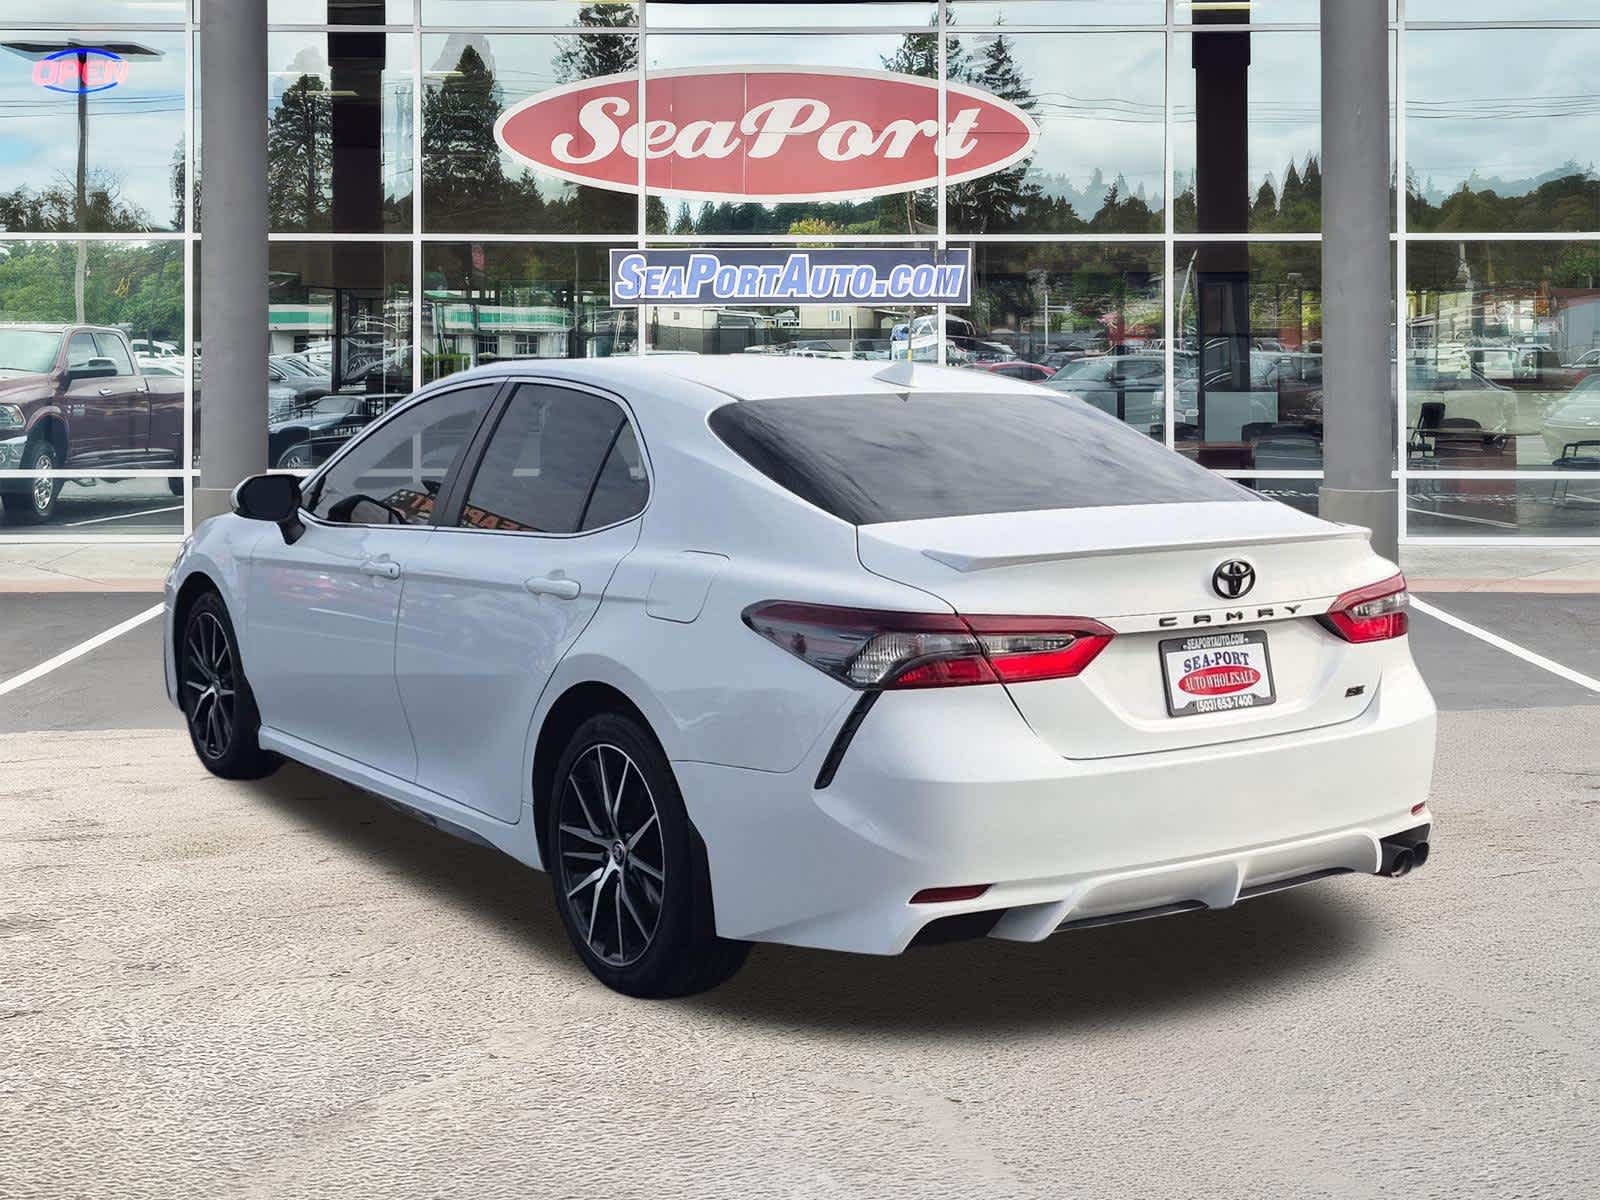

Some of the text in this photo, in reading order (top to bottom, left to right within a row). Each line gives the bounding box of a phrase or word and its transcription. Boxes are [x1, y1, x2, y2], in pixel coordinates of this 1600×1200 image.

[32, 59, 129, 86] OPEN
[550, 96, 982, 165] SeaPort
[1158, 604, 1302, 628] CAMRY
[1184, 670, 1257, 692] AUTO WHOLESALE
